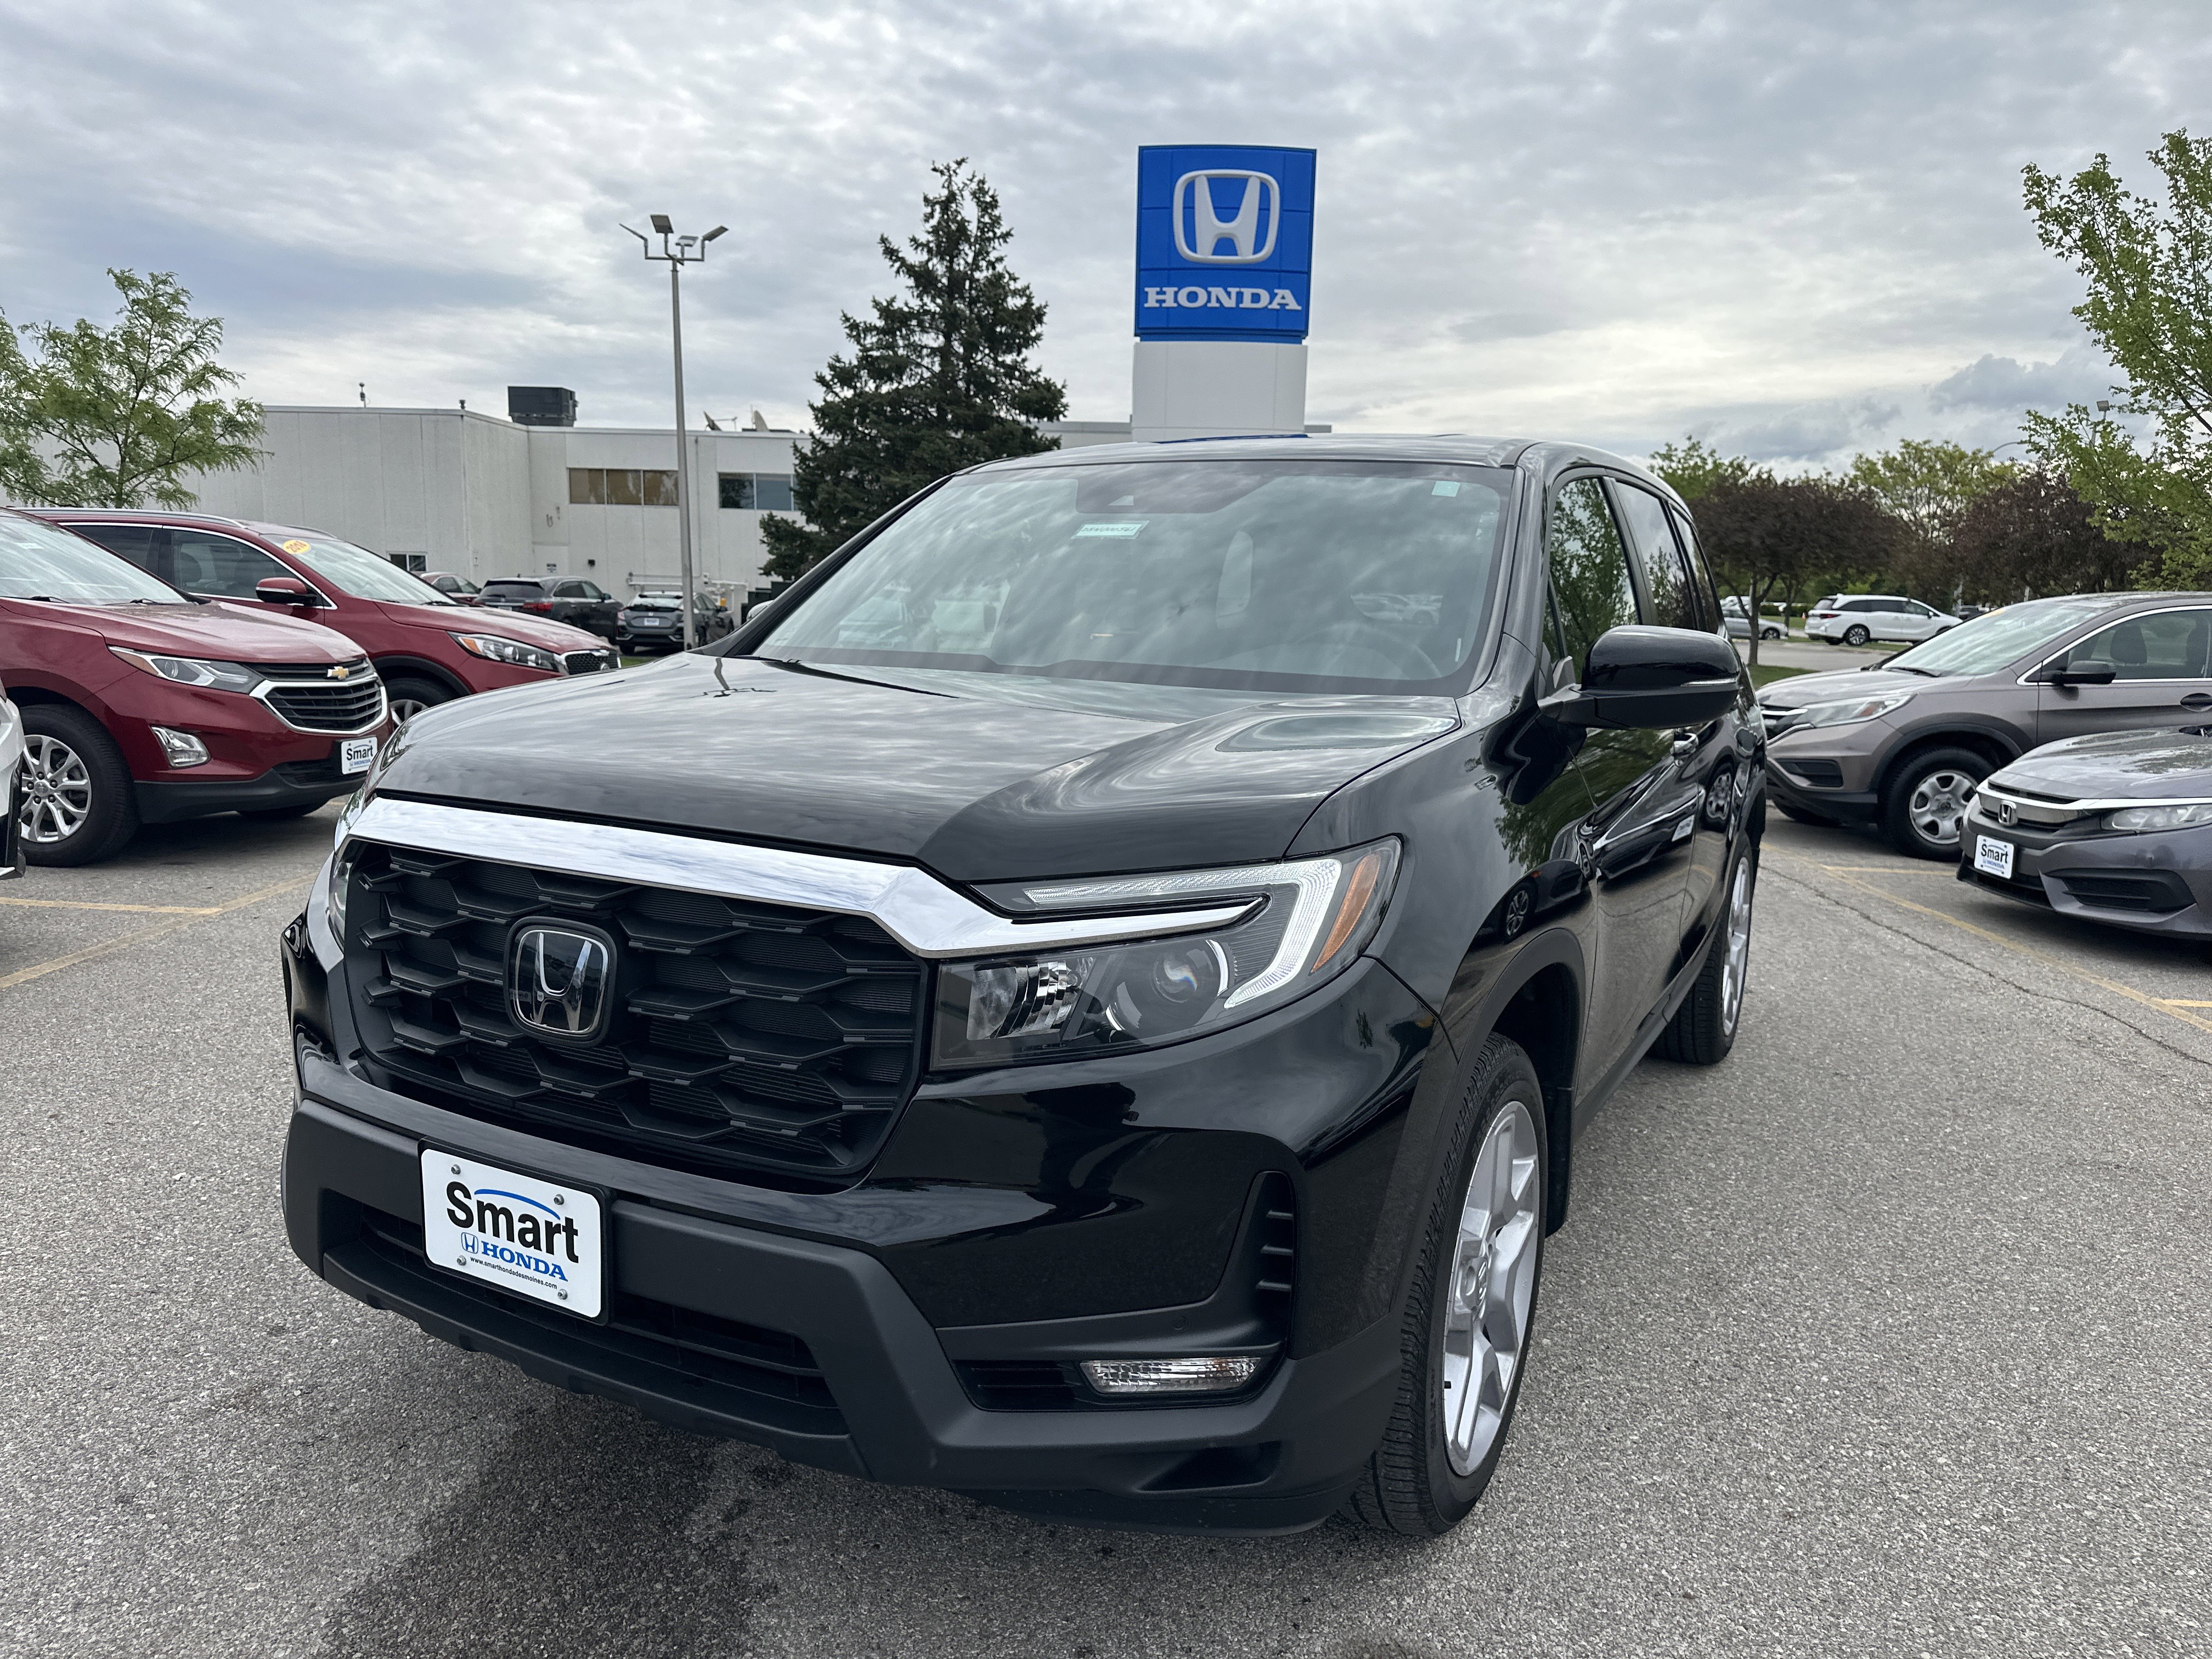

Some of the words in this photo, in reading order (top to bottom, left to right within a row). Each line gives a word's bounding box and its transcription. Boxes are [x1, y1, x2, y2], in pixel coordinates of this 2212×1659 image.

[1144, 286, 1302, 311] HONDA
[346, 745, 373, 760] Smart
[1981, 844, 2008, 864] Smart
[447, 1181, 579, 1263] Smart
[470, 1256, 557, 1290] www.smarthondadesmoines.com
[481, 1240, 568, 1282] HONDA
